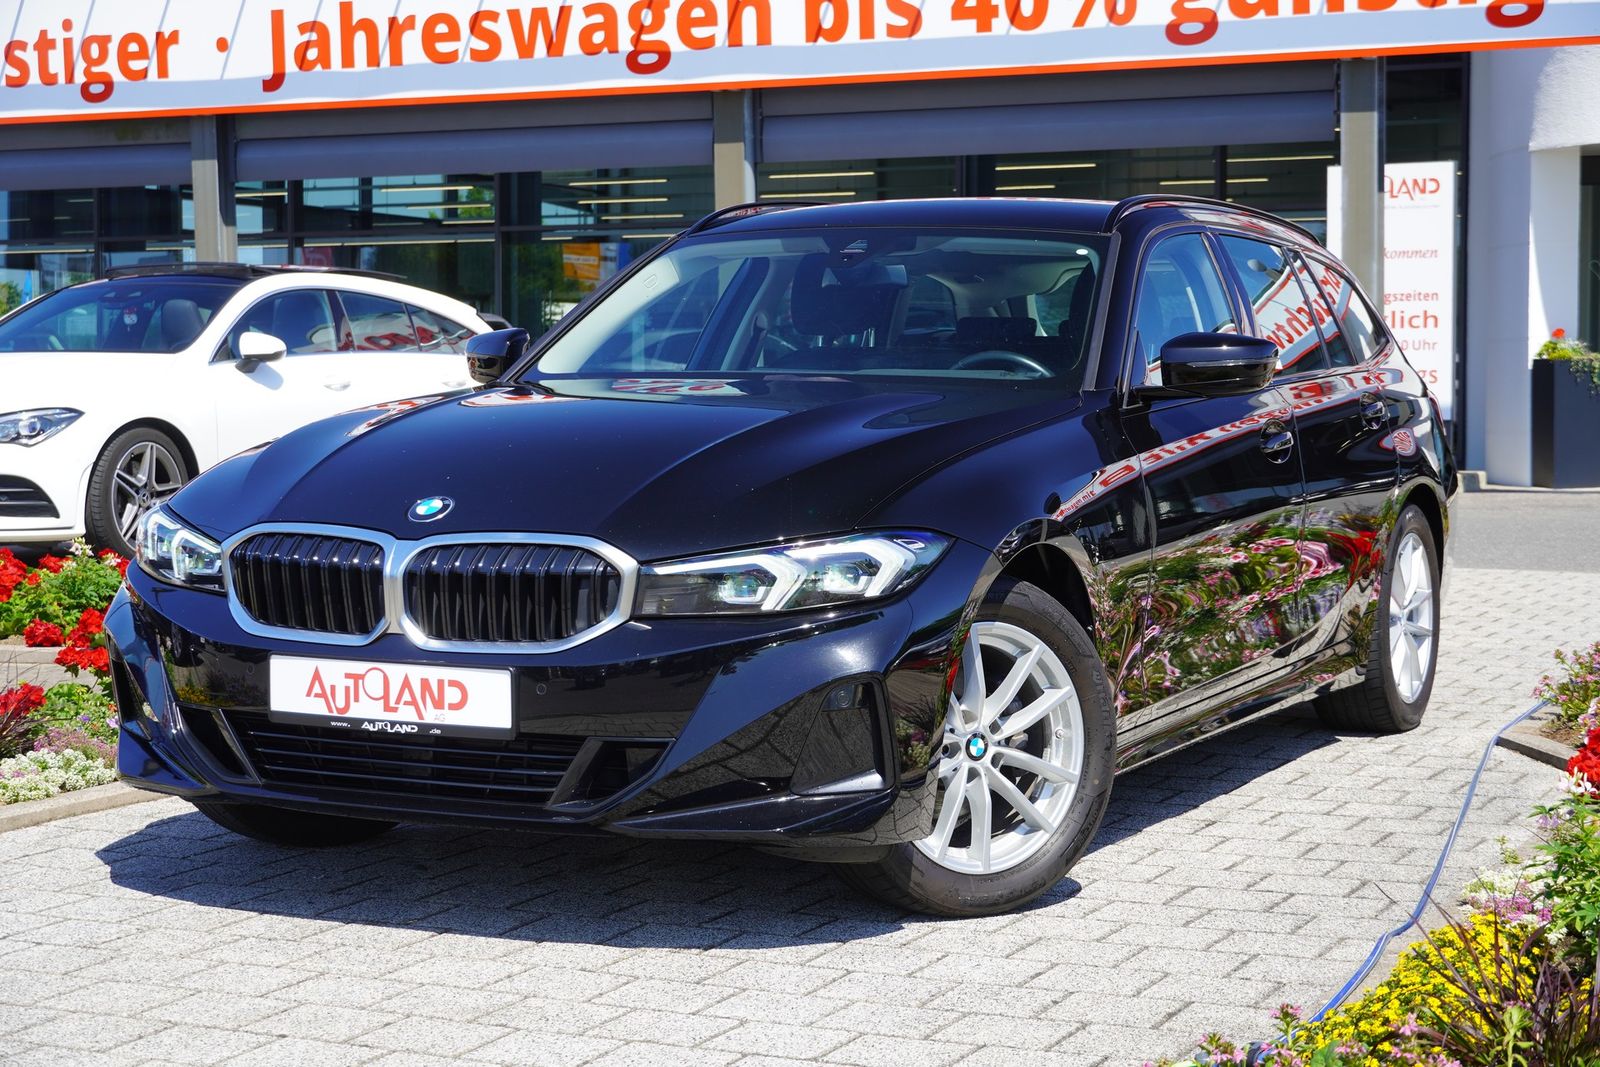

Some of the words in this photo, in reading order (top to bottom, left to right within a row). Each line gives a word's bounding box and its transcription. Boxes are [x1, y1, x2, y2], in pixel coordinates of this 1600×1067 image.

[4, 19, 180, 103] stiger
[261, 0, 773, 92] Jahreswagen
[1383, 310, 1439, 329] lich
[1412, 339, 1438, 351] Uhr
[305, 665, 469, 721] AUTOLAND
[361, 721, 419, 734] AUTOLAND
